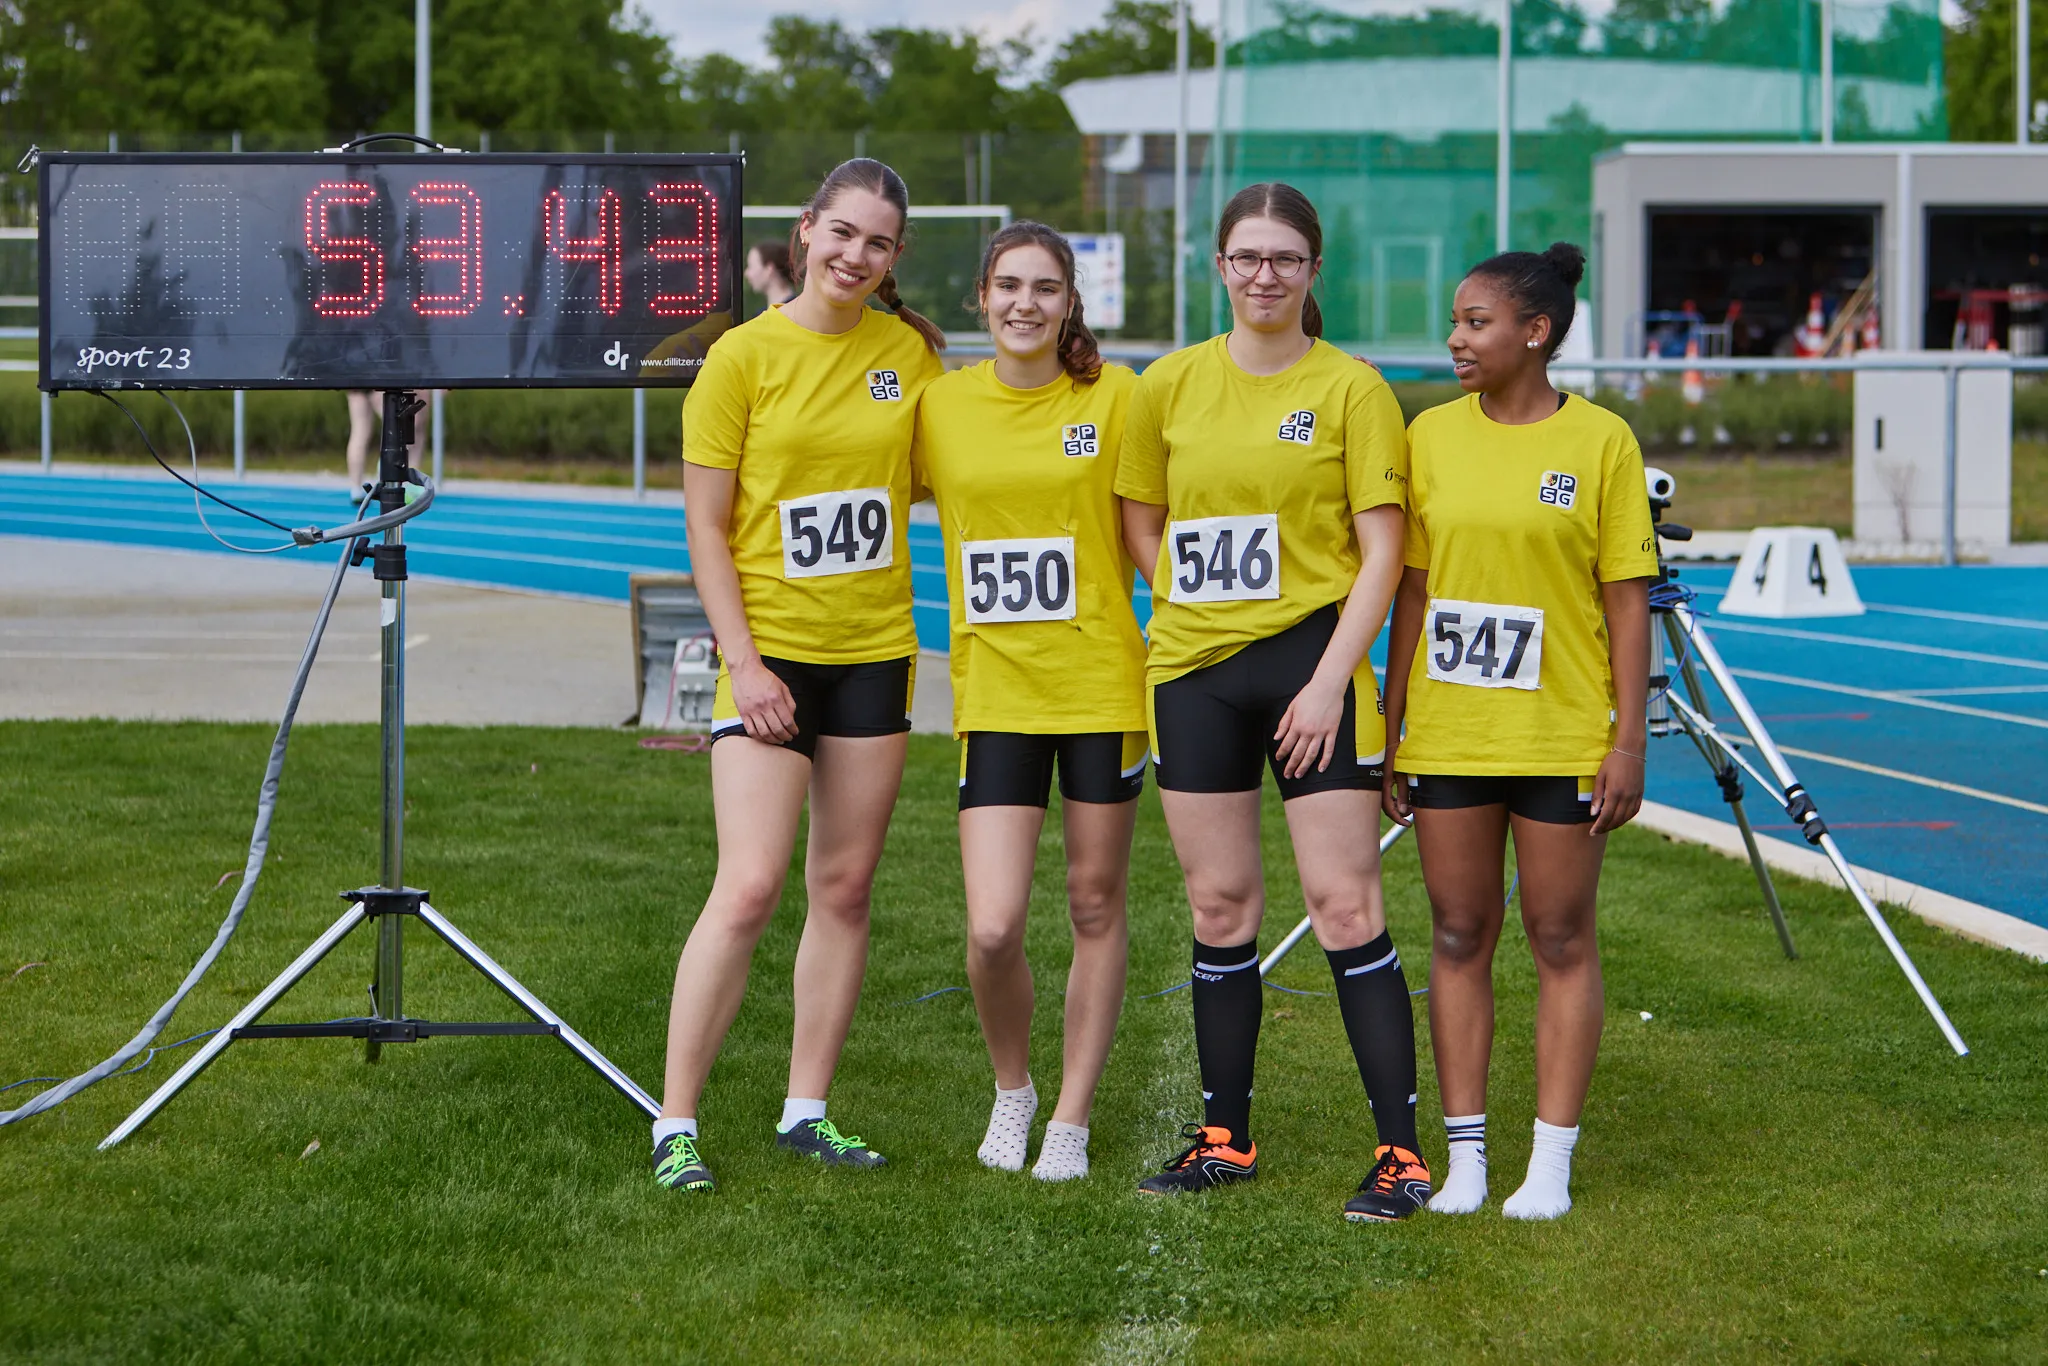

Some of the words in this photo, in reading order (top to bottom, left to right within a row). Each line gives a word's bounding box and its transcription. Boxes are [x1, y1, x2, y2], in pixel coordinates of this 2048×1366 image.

[76, 346, 154, 373] sport
[157, 347, 191, 370] 23
[603, 340, 630, 371] dr
[789, 499, 887, 568] 549
[1175, 527, 1273, 594] 546
[969, 549, 1070, 614] 550
[1808, 541, 1827, 596] 4
[1434, 611, 1537, 680] 547
